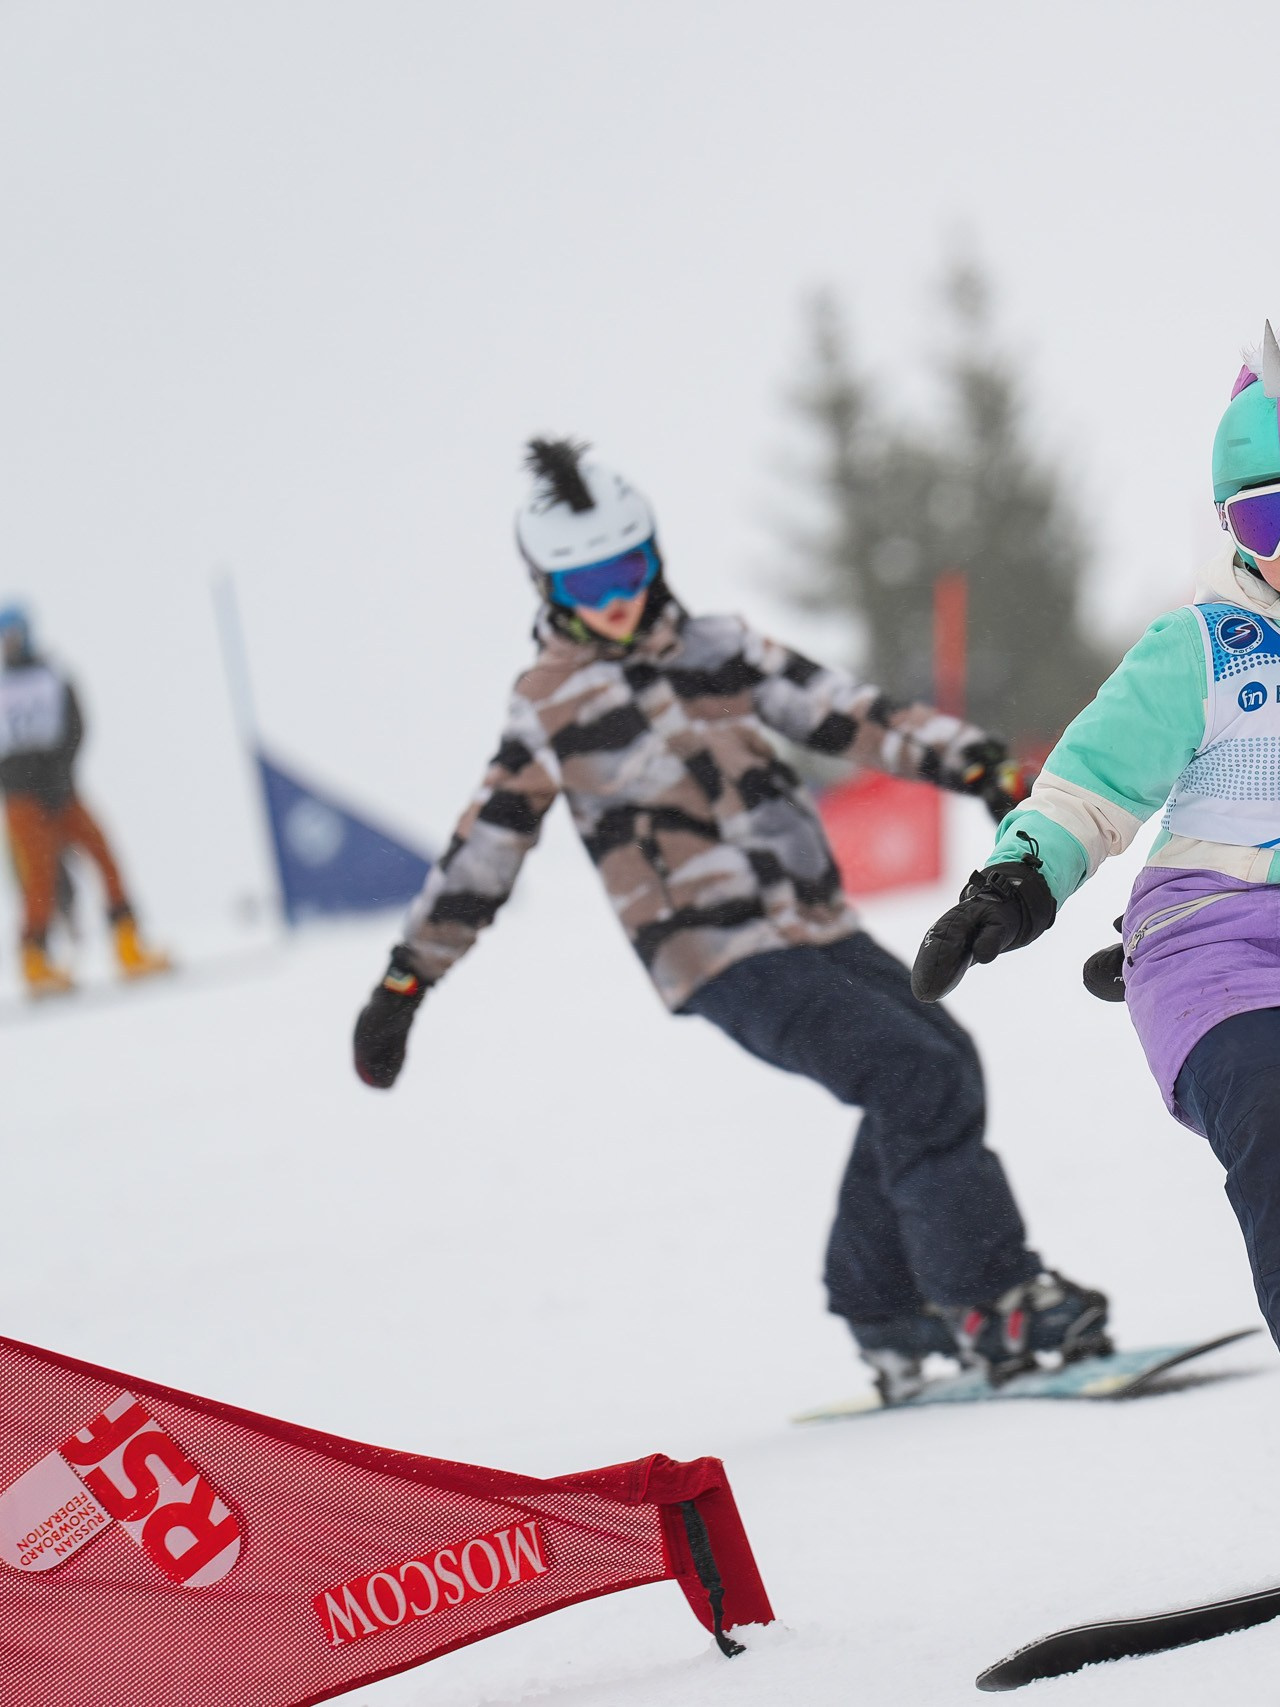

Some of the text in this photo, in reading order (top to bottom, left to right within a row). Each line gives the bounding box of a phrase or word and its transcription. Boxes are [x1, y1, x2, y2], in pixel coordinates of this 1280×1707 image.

[16, 1491, 88, 1552] FEDERATION
[20, 1502, 96, 1566] SNOWBOARD
[53, 1512, 105, 1557] RUSSIAN
[324, 1521, 548, 1645] MOSCOW
